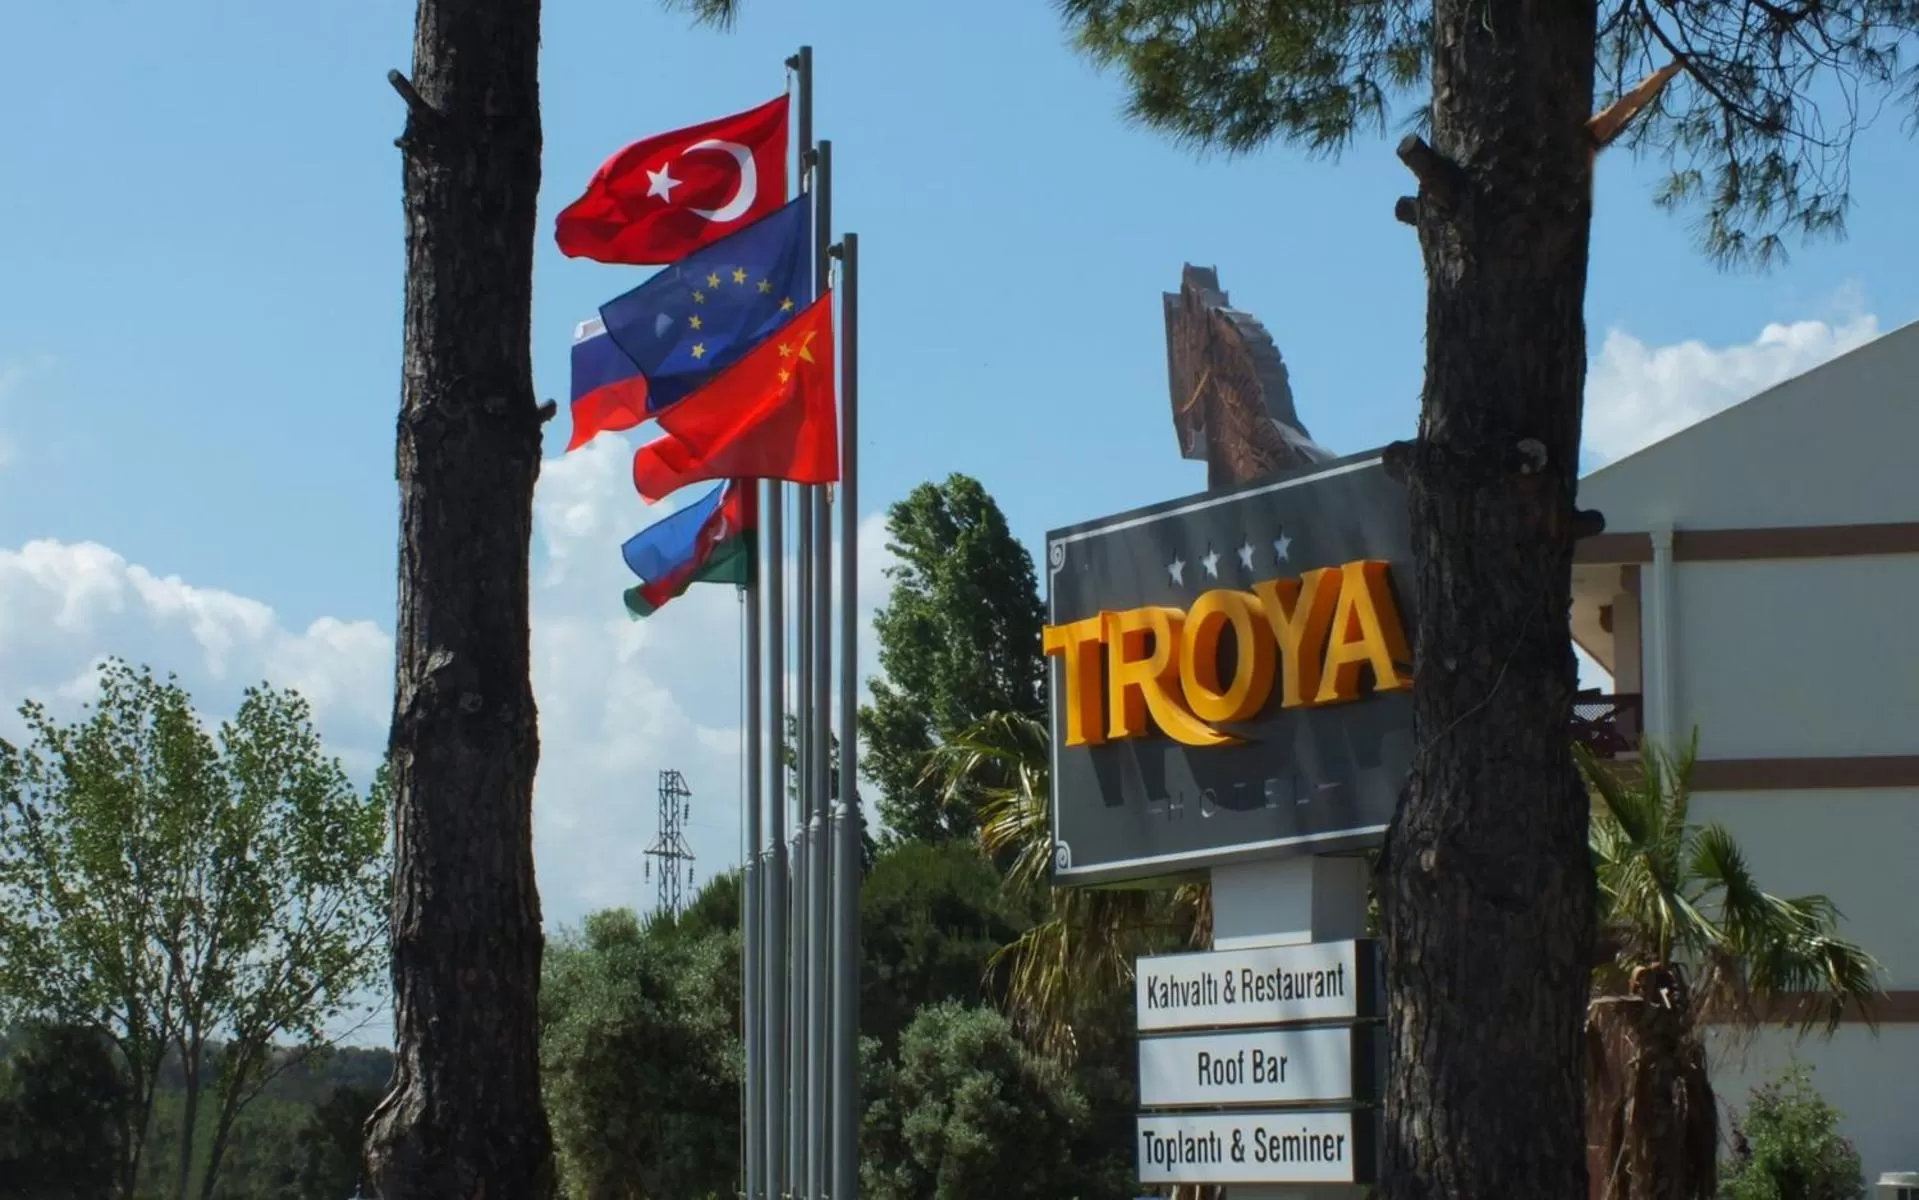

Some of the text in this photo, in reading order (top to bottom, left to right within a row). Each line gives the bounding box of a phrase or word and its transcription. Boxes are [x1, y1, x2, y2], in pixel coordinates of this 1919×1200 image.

[1044, 561, 1412, 746] TROYA
[1147, 963, 1345, 1009] Kahvaltı & Restaurant
[1198, 1049, 1287, 1086] Roof Bar
[1143, 1127, 1345, 1171] Toplantı & Seminer
